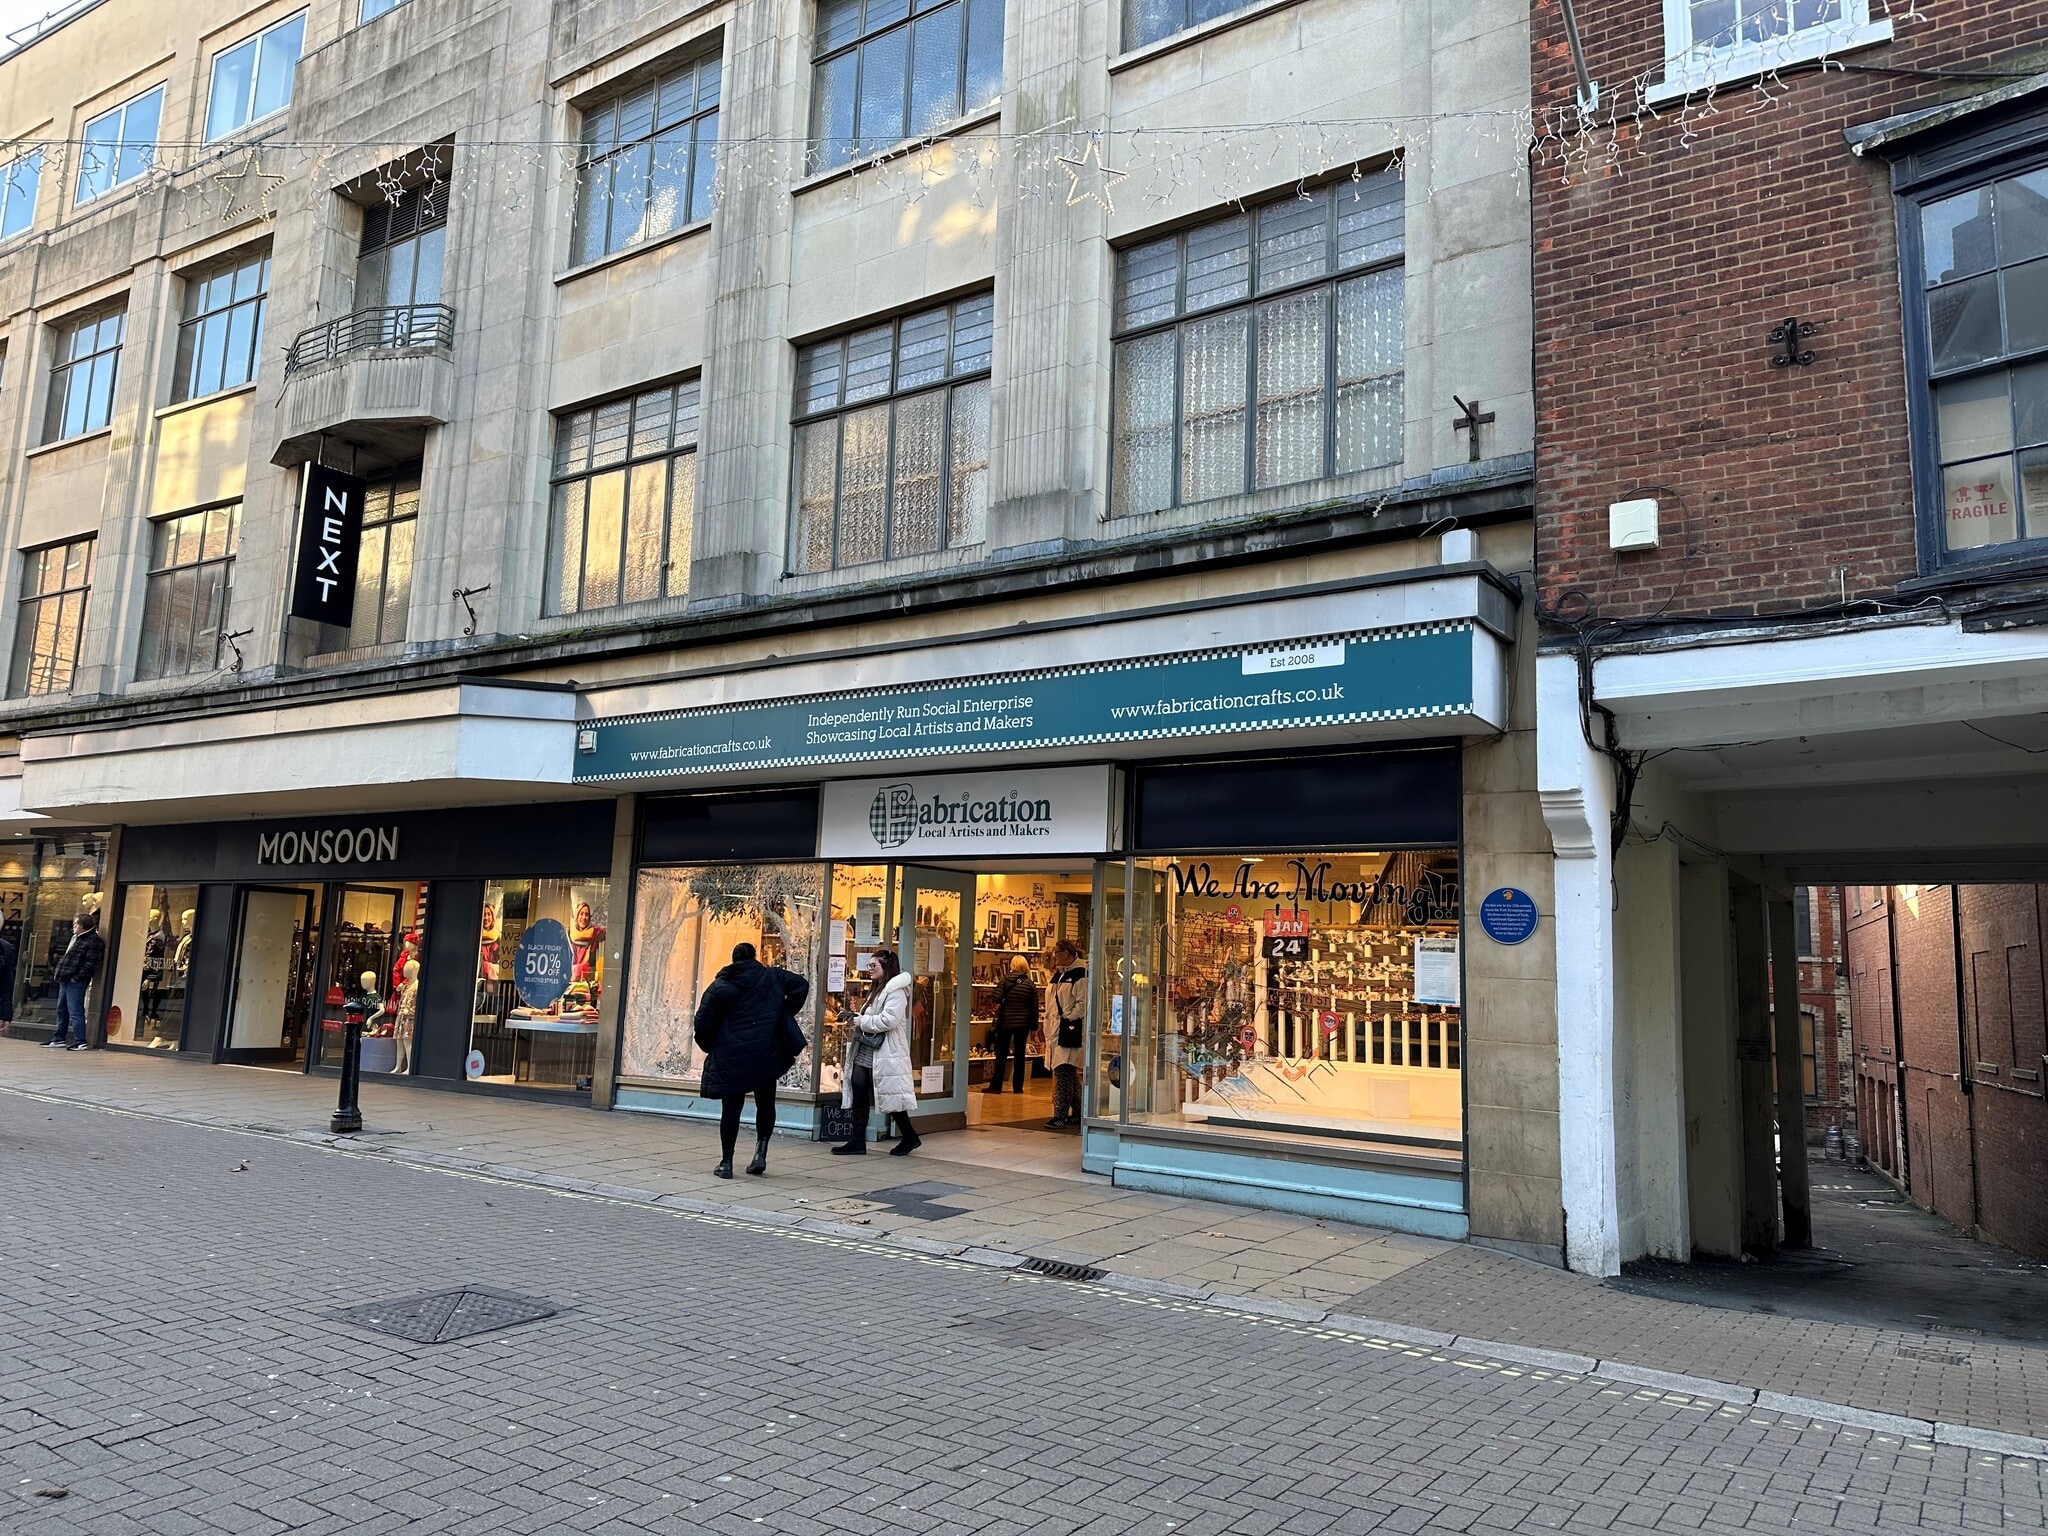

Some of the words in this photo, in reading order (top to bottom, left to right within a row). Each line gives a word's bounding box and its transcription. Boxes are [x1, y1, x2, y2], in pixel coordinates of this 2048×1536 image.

[316, 486, 348, 602] NEXT
[1270, 656, 1286, 667] Est
[1287, 653, 1315, 666] 2008
[807, 706, 895, 727] Independently
[896, 705, 921, 719] Run
[922, 700, 960, 717] Social
[962, 695, 1034, 713] Enterprise
[1111, 683, 1344, 719] www.fabricationcrafts.co.uk
[806, 726, 877, 745] Showcasing
[878, 722, 912, 739] Local
[913, 719, 954, 736] Artists
[956, 717, 981, 733] and
[983, 714, 1034, 731] Makers
[630, 735, 772, 761] www.fabricationcrafts.co.uk
[869, 783, 1052, 849] Fabrication
[918, 825, 946, 838] Local
[948, 825, 985, 838] Artists
[986, 824, 1007, 837] and
[1008, 823, 1051, 837] Makers
[257, 826, 399, 864] MONSOON
[1166, 862, 1220, 898] We
[1222, 862, 1280, 899] Are
[1272, 920, 1303, 934] JAN
[525, 952, 561, 975] 50%
[547, 968, 560, 976] OFF
[827, 1106, 841, 1118] We
[844, 1109, 853, 1118] ar
